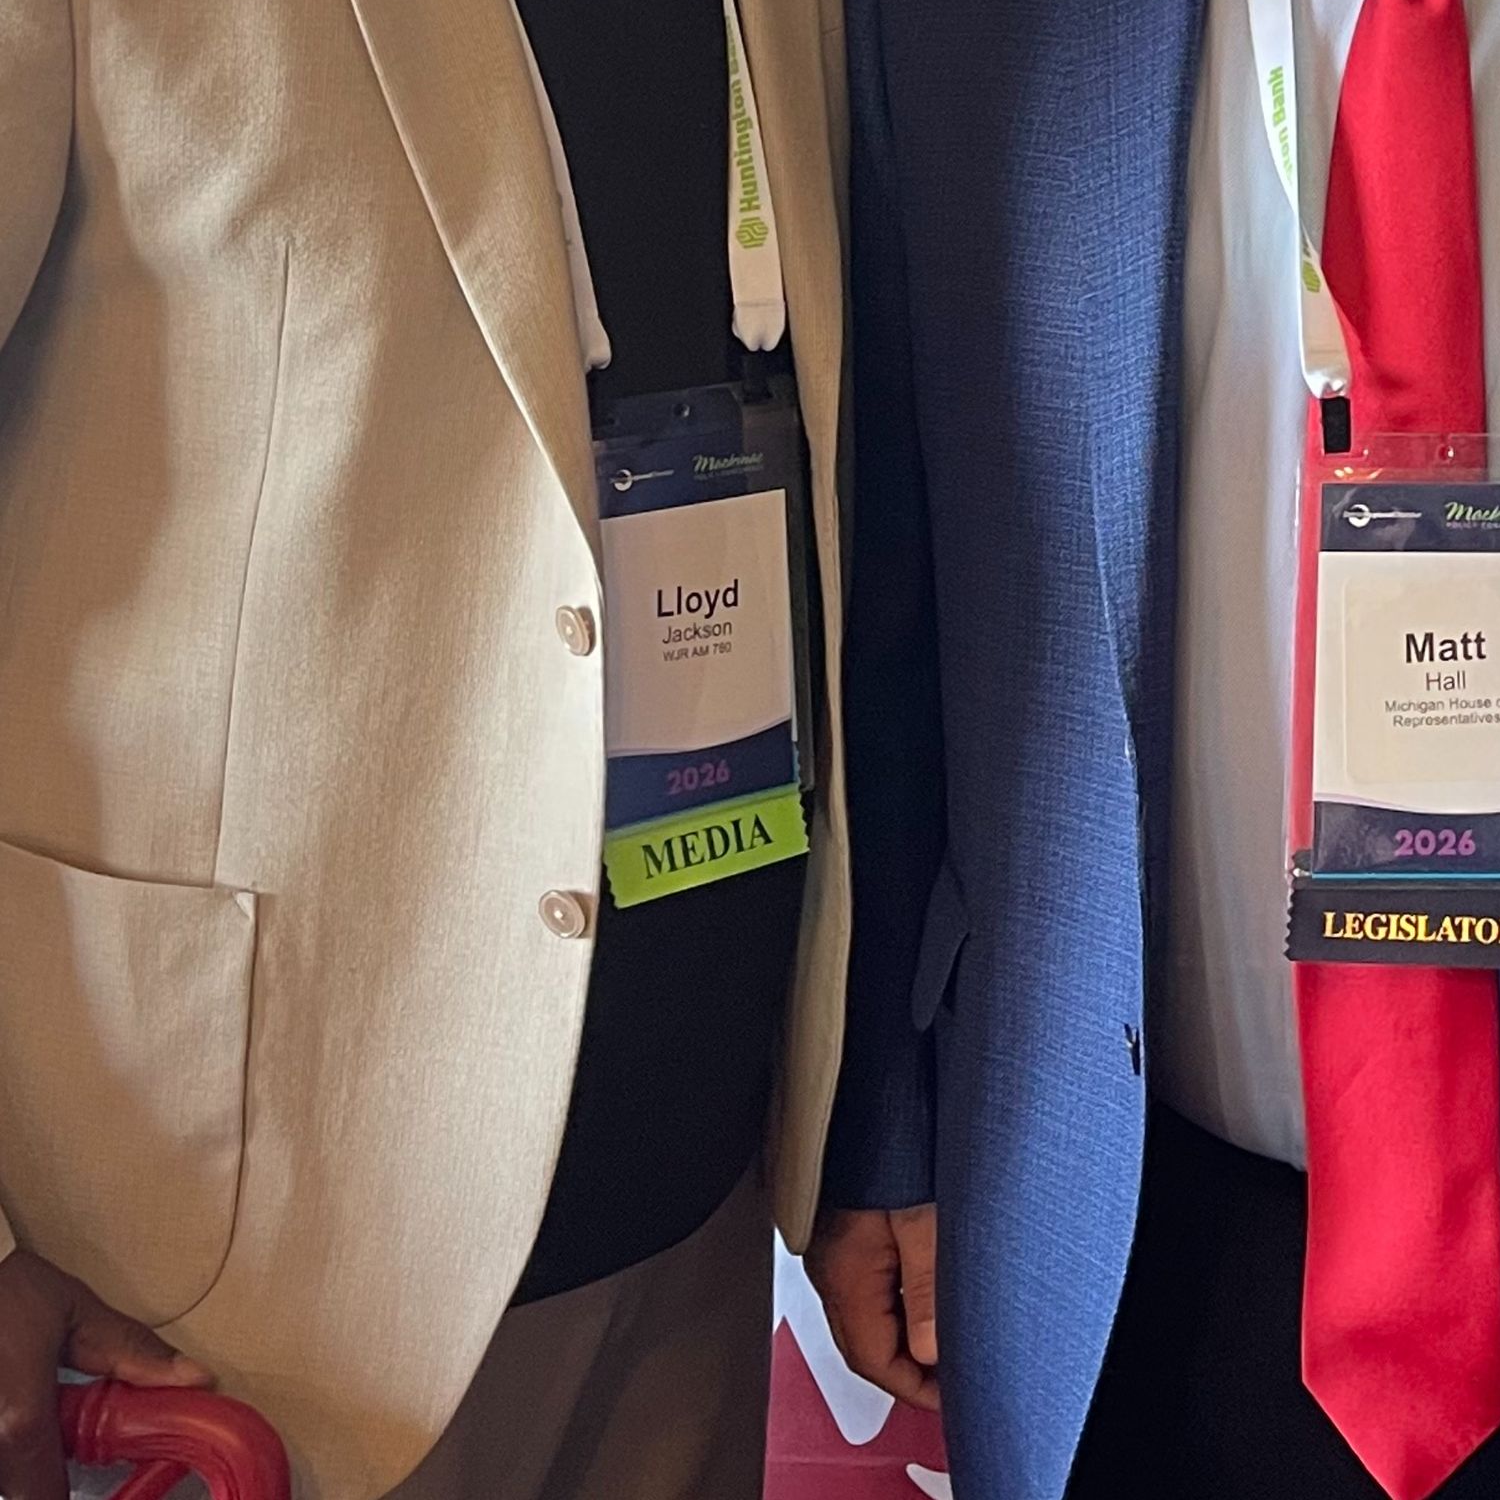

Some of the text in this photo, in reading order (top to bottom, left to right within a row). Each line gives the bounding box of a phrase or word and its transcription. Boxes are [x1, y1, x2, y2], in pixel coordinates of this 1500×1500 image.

[1267, 66, 1286, 128] Bank
[731, 79, 761, 213] Huntington
[657, 578, 739, 619] Lloyd
[662, 622, 732, 644] Jackson
[1405, 631, 1487, 663] Matt
[663, 647, 689, 661] WJR
[691, 645, 709, 657] AM
[1425, 670, 1466, 691] Hall
[1384, 699, 1445, 713] Michigan
[1448, 697, 1492, 709] House
[1392, 712, 1500, 728] Representatives
[667, 759, 730, 795] 2026
[642, 813, 773, 879] MEDIA
[1394, 829, 1476, 856] 2026
